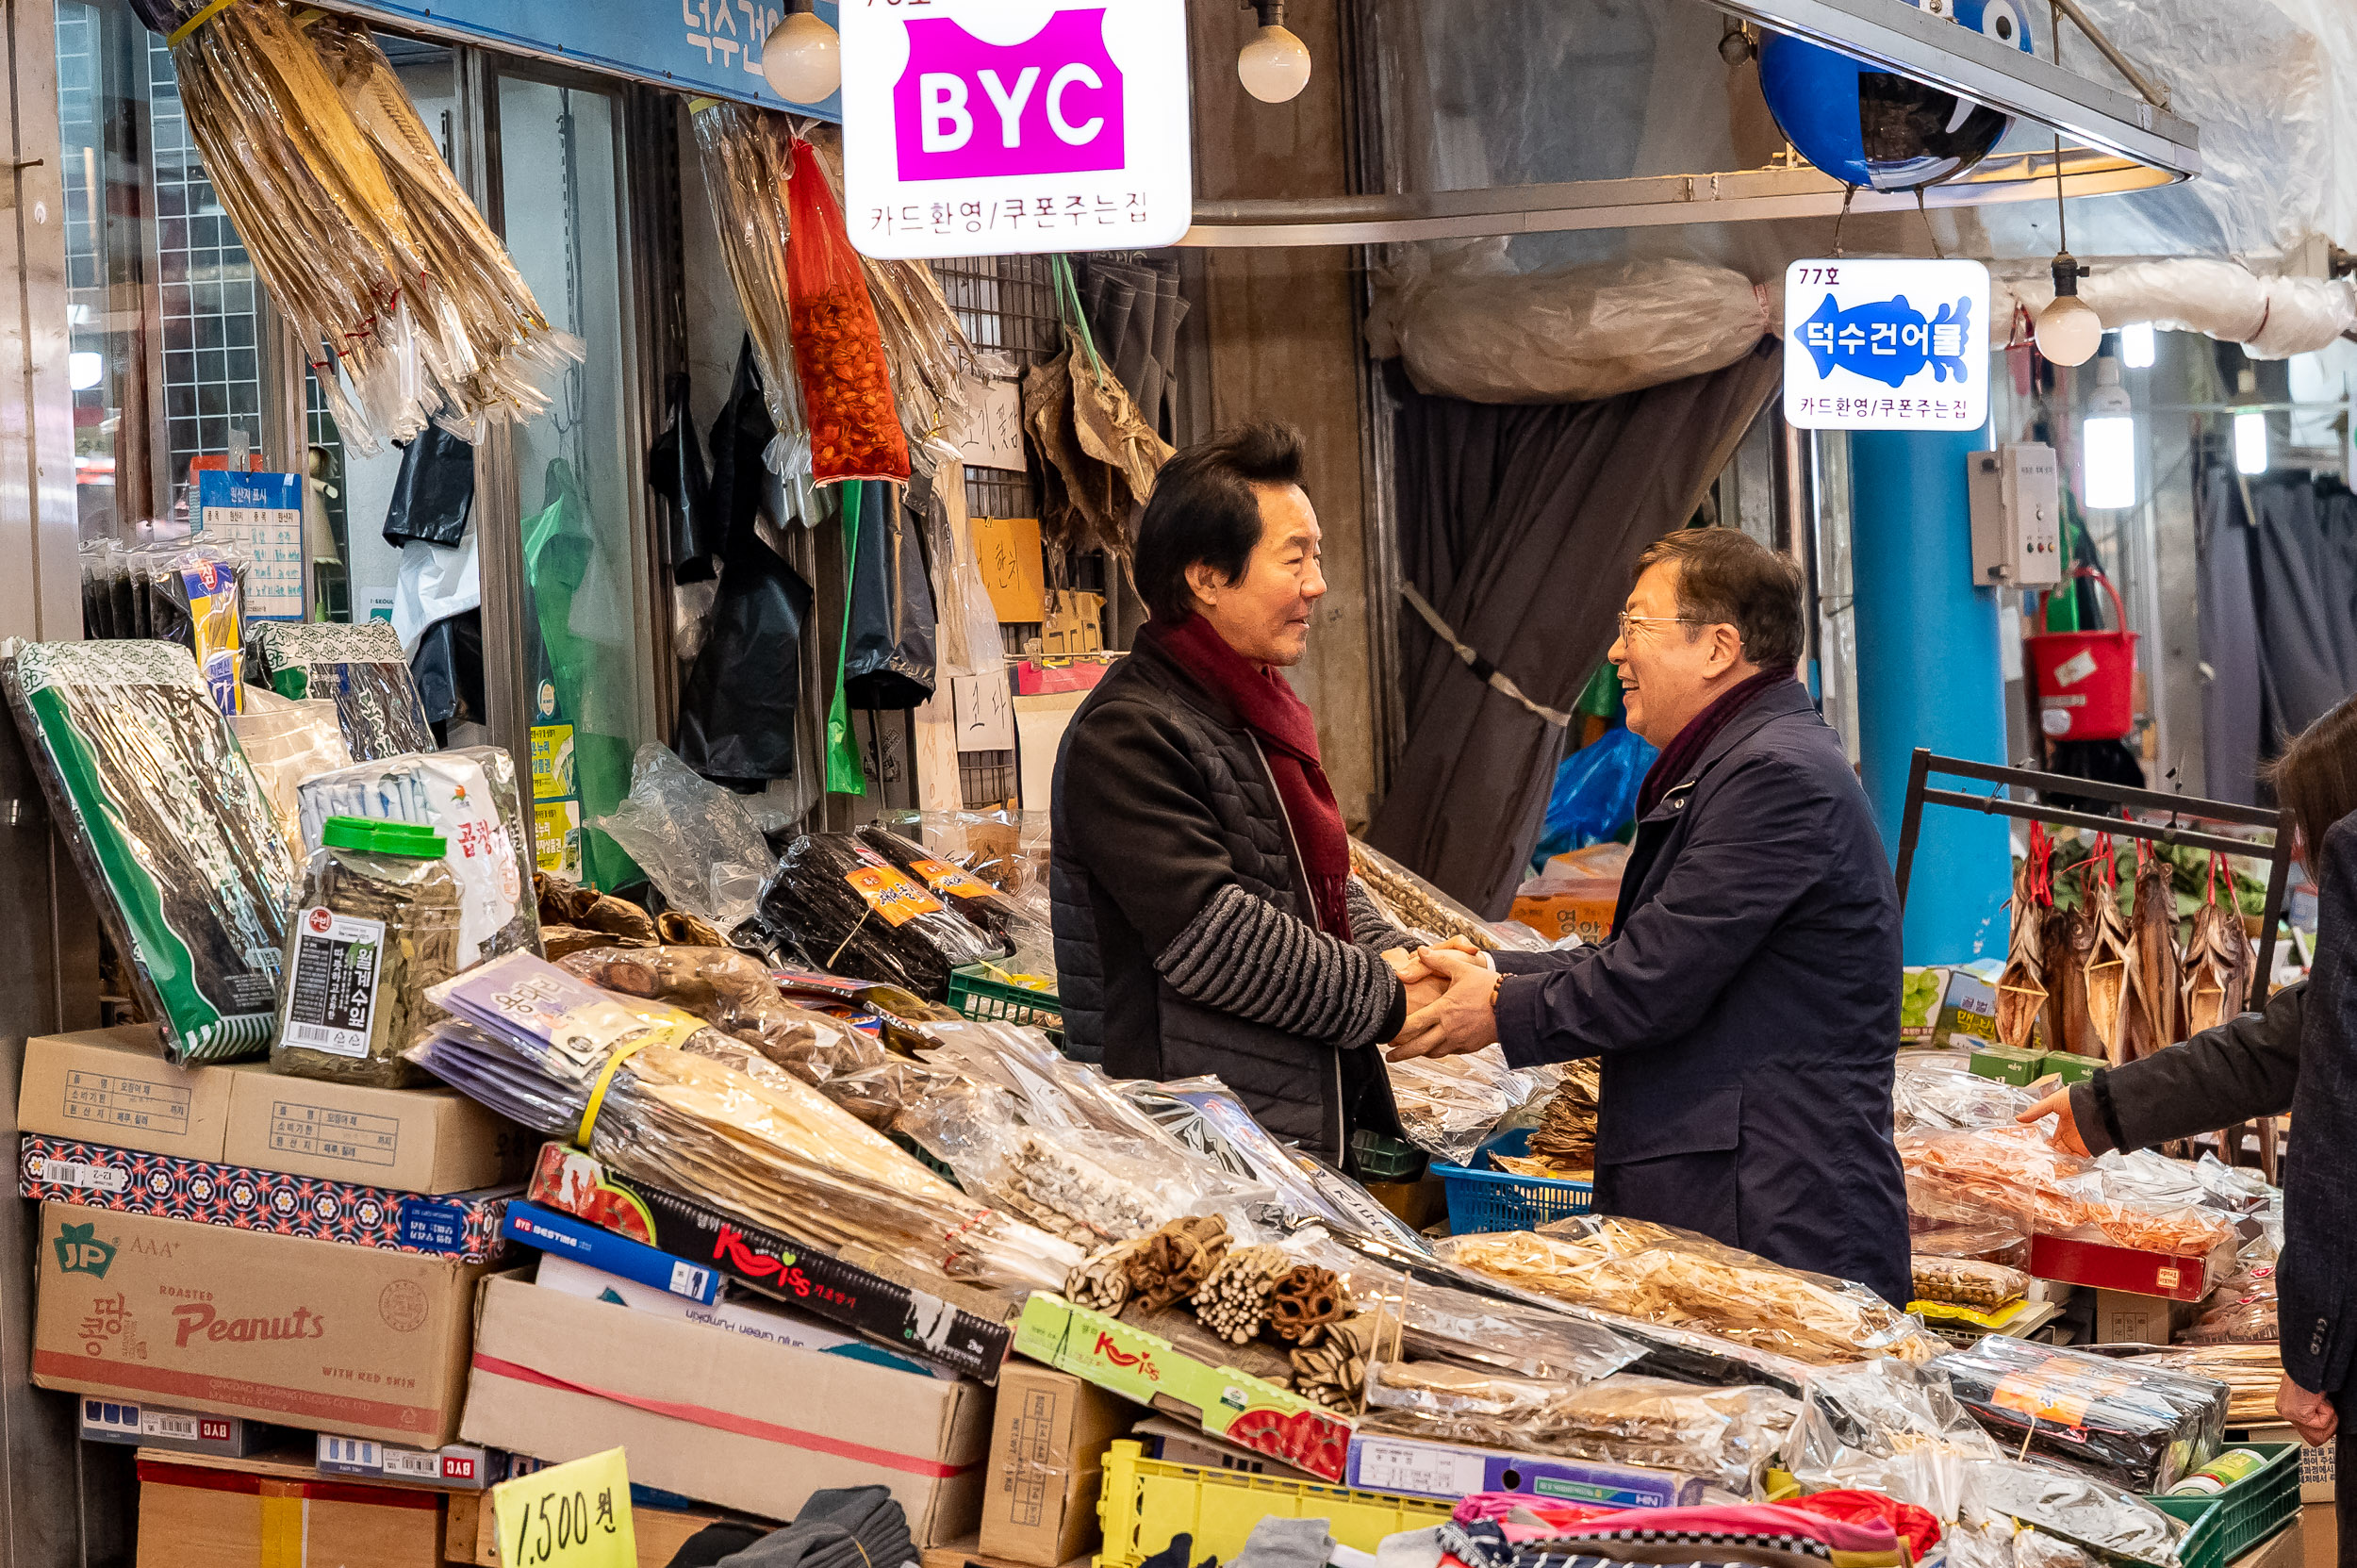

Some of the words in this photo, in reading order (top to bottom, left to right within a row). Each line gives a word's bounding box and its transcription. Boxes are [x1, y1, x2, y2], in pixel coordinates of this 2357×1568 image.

[919, 62, 1105, 154] BYC
[871, 192, 1146, 236] 카드환영/쿠폰주는집
[1799, 267, 1839, 285] 77호
[1807, 322, 1962, 356] 덕수건어물
[1800, 397, 1968, 419] 카드환영/쿠폰주는집
[230, 487, 251, 503] 원산지
[253, 488, 267, 503] 표시
[309, 913, 330, 931] 수빈
[348, 948, 374, 1028] 월계수잎
[514, 1218, 533, 1231] BYC
[65, 1244, 106, 1268] JP
[158, 1285, 214, 1301] ROASTED
[77, 1292, 133, 1357] 땅콩
[172, 1302, 325, 1349] Peanuts
[685, 1308, 735, 1332] Pumpkin
[1094, 1330, 1161, 1382] Kiss
[322, 1366, 354, 1380] WITH
[358, 1372, 381, 1383] RED
[386, 1377, 415, 1389] SKIN
[203, 1422, 227, 1439] BYC
[446, 1460, 471, 1477] BYC
[595, 1487, 617, 1534] 원
